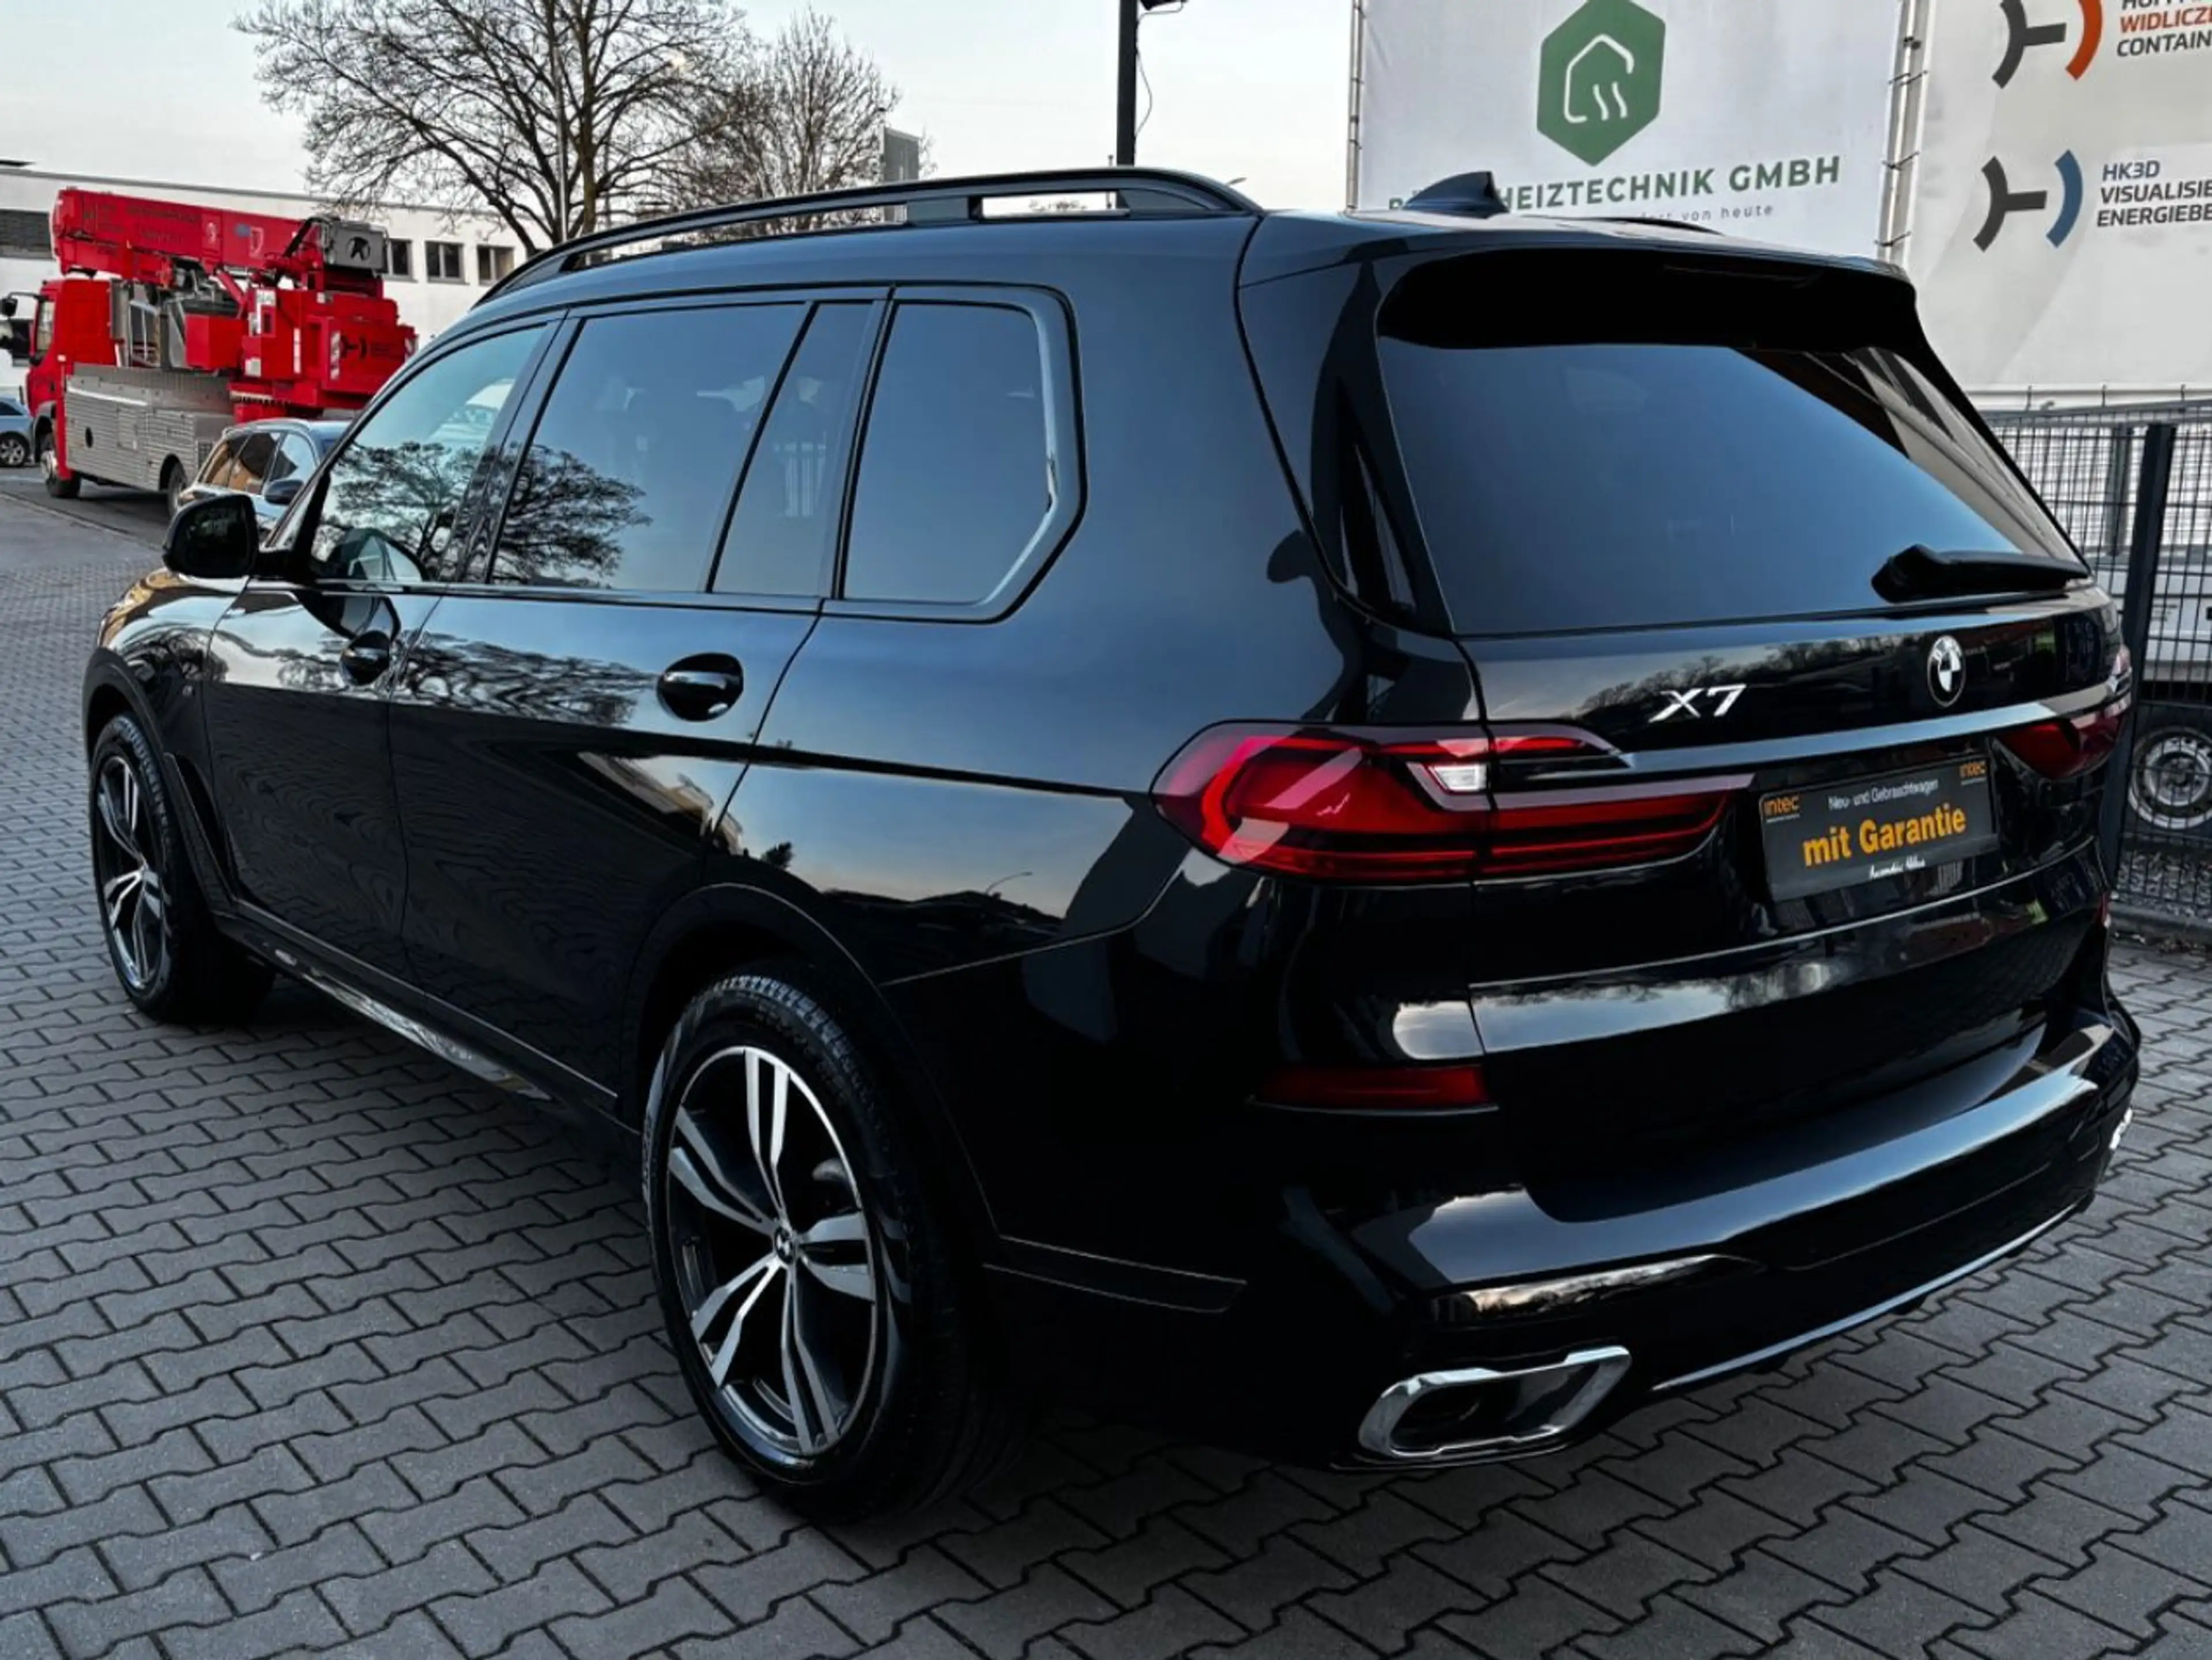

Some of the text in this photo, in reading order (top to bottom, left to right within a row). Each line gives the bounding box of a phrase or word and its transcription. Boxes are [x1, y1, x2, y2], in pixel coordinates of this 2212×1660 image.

[1729, 156, 1840, 191] GMBH
[2102, 160, 2161, 182] HK3D
[1682, 210, 1712, 221] von
[1721, 205, 1773, 220] heute
[1649, 684, 1747, 723] X7
[1803, 802, 1966, 867] mit Garantie
